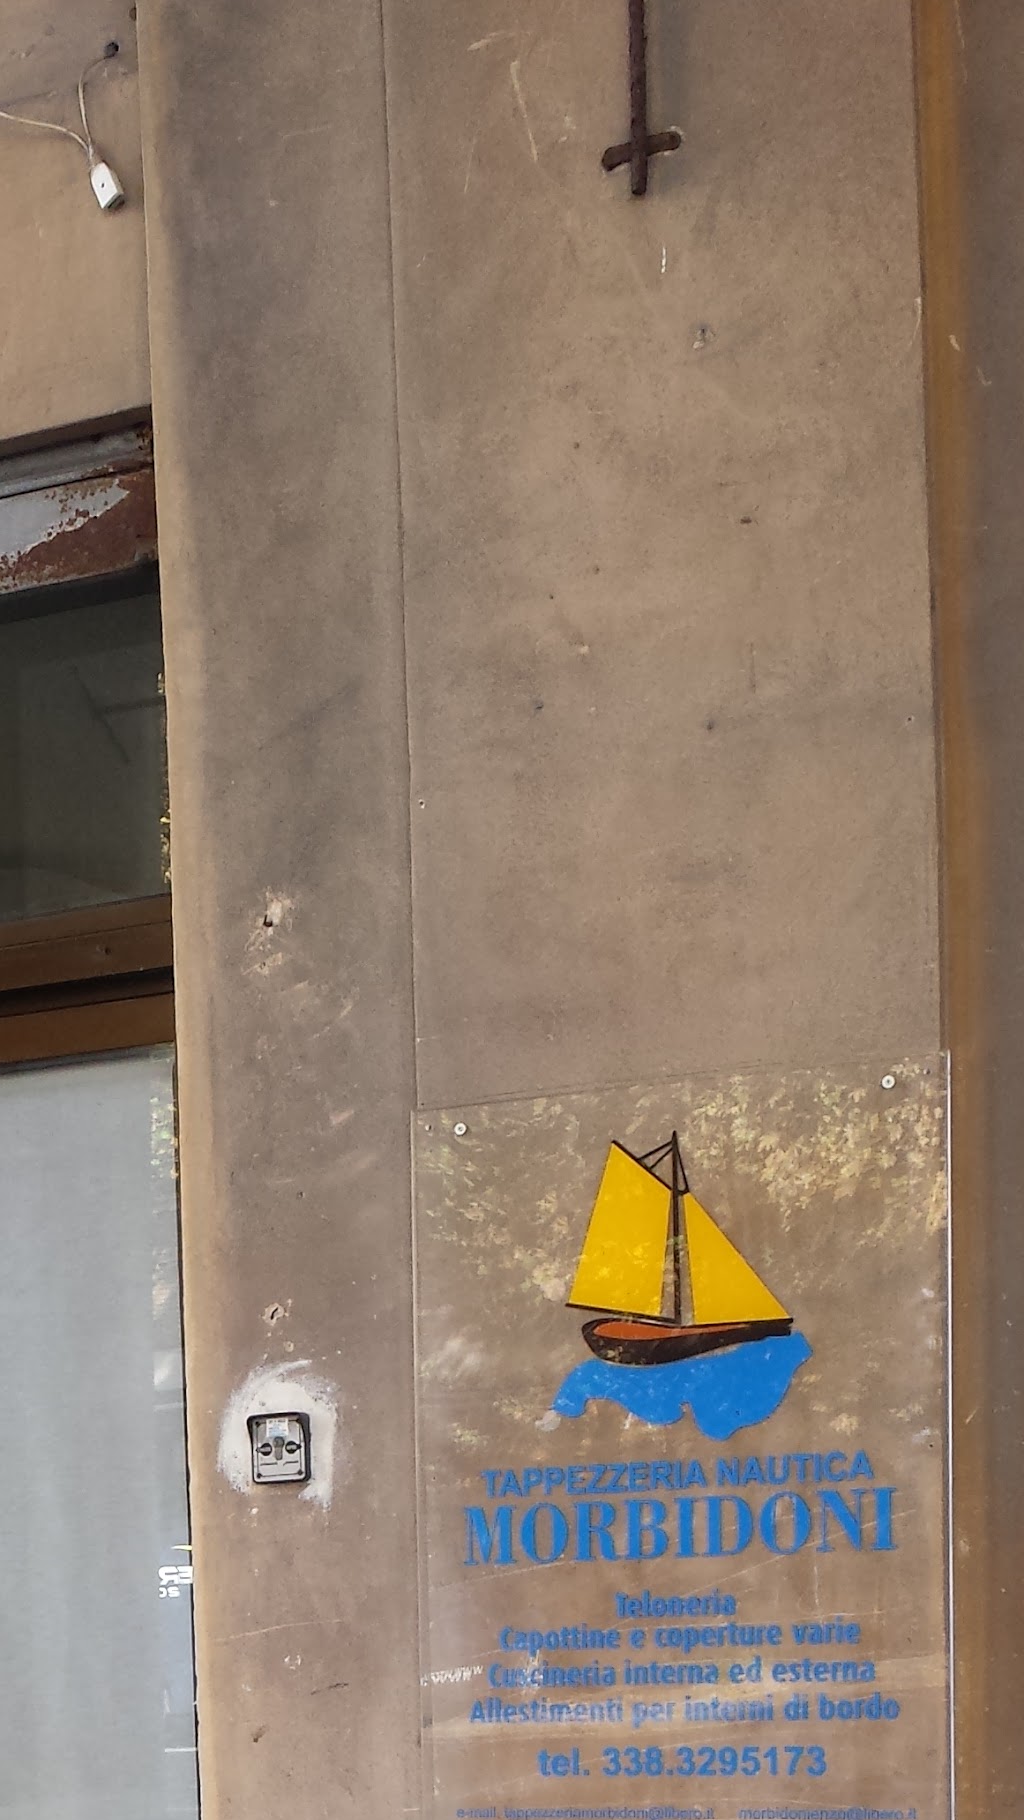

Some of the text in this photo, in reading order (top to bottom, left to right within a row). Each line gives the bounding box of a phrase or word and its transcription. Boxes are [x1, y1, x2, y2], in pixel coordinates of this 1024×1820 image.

[481, 1449, 875, 1497] TAPPEZZERIA NAUTICA
[463, 1487, 897, 1567] MORBIDONI
[614, 1588, 737, 1618] Teloneria
[499, 1616, 861, 1657] Capottine e coperture varie
[488, 1655, 876, 1689] Cuscineria interna ed esterna
[469, 1692, 901, 1729] Allestimenti per interni di bordo
[538, 1745, 827, 1777] tel. 338.3295173
